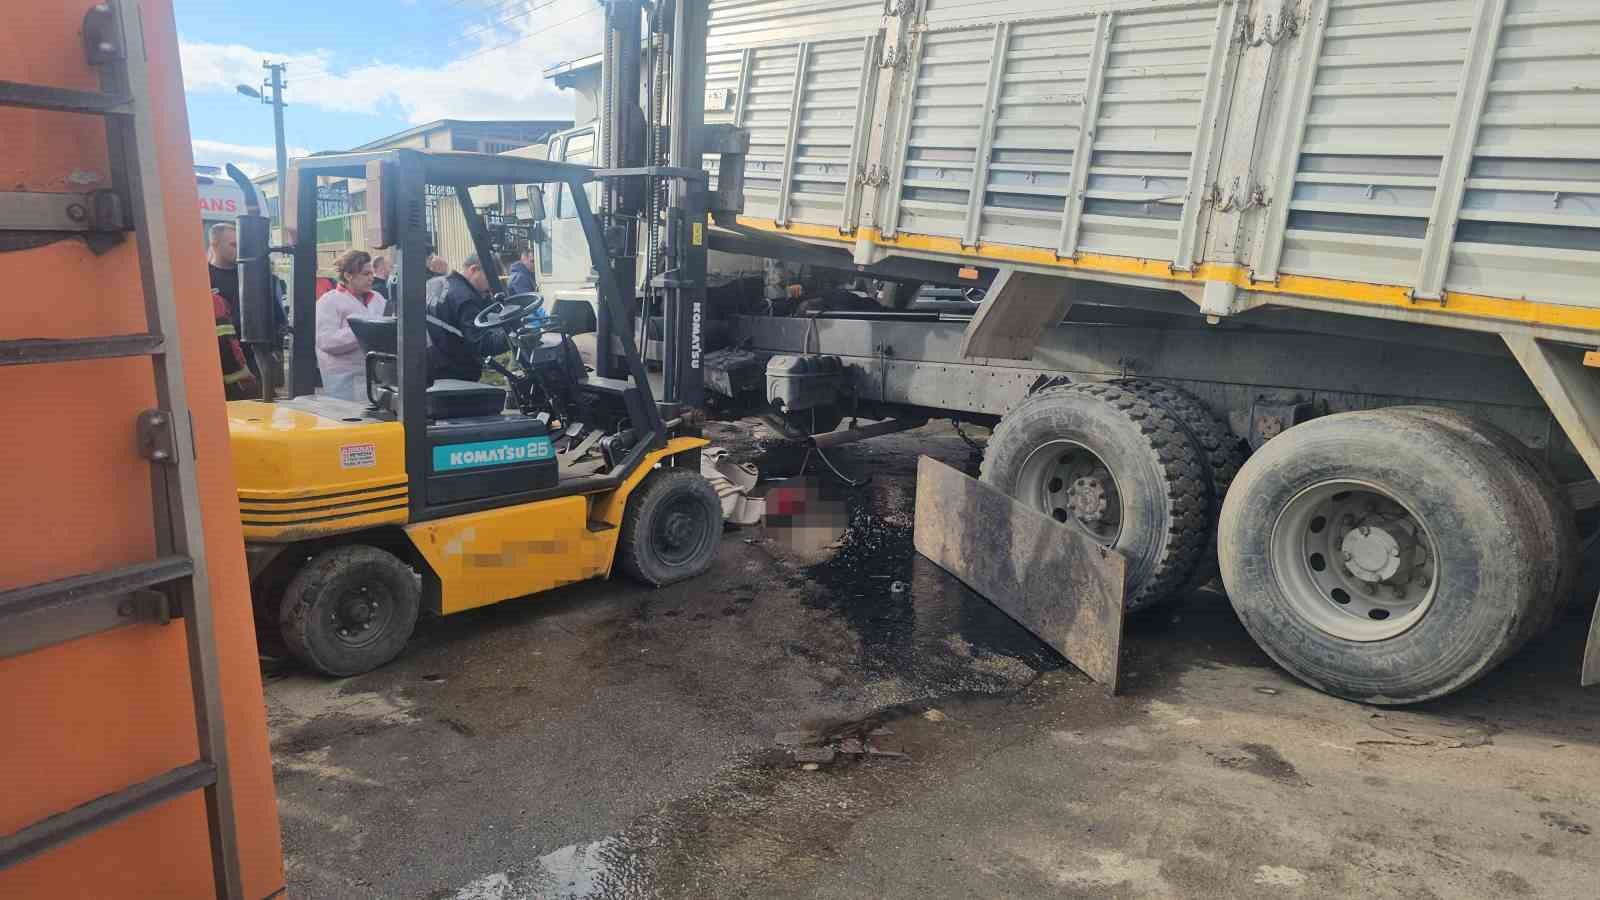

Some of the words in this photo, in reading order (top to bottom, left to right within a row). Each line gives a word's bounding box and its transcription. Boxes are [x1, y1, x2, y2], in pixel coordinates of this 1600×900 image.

[691, 302, 702, 369] KOMATSU
[450, 445, 525, 465] KOMATSU
[527, 442, 548, 458] 25
